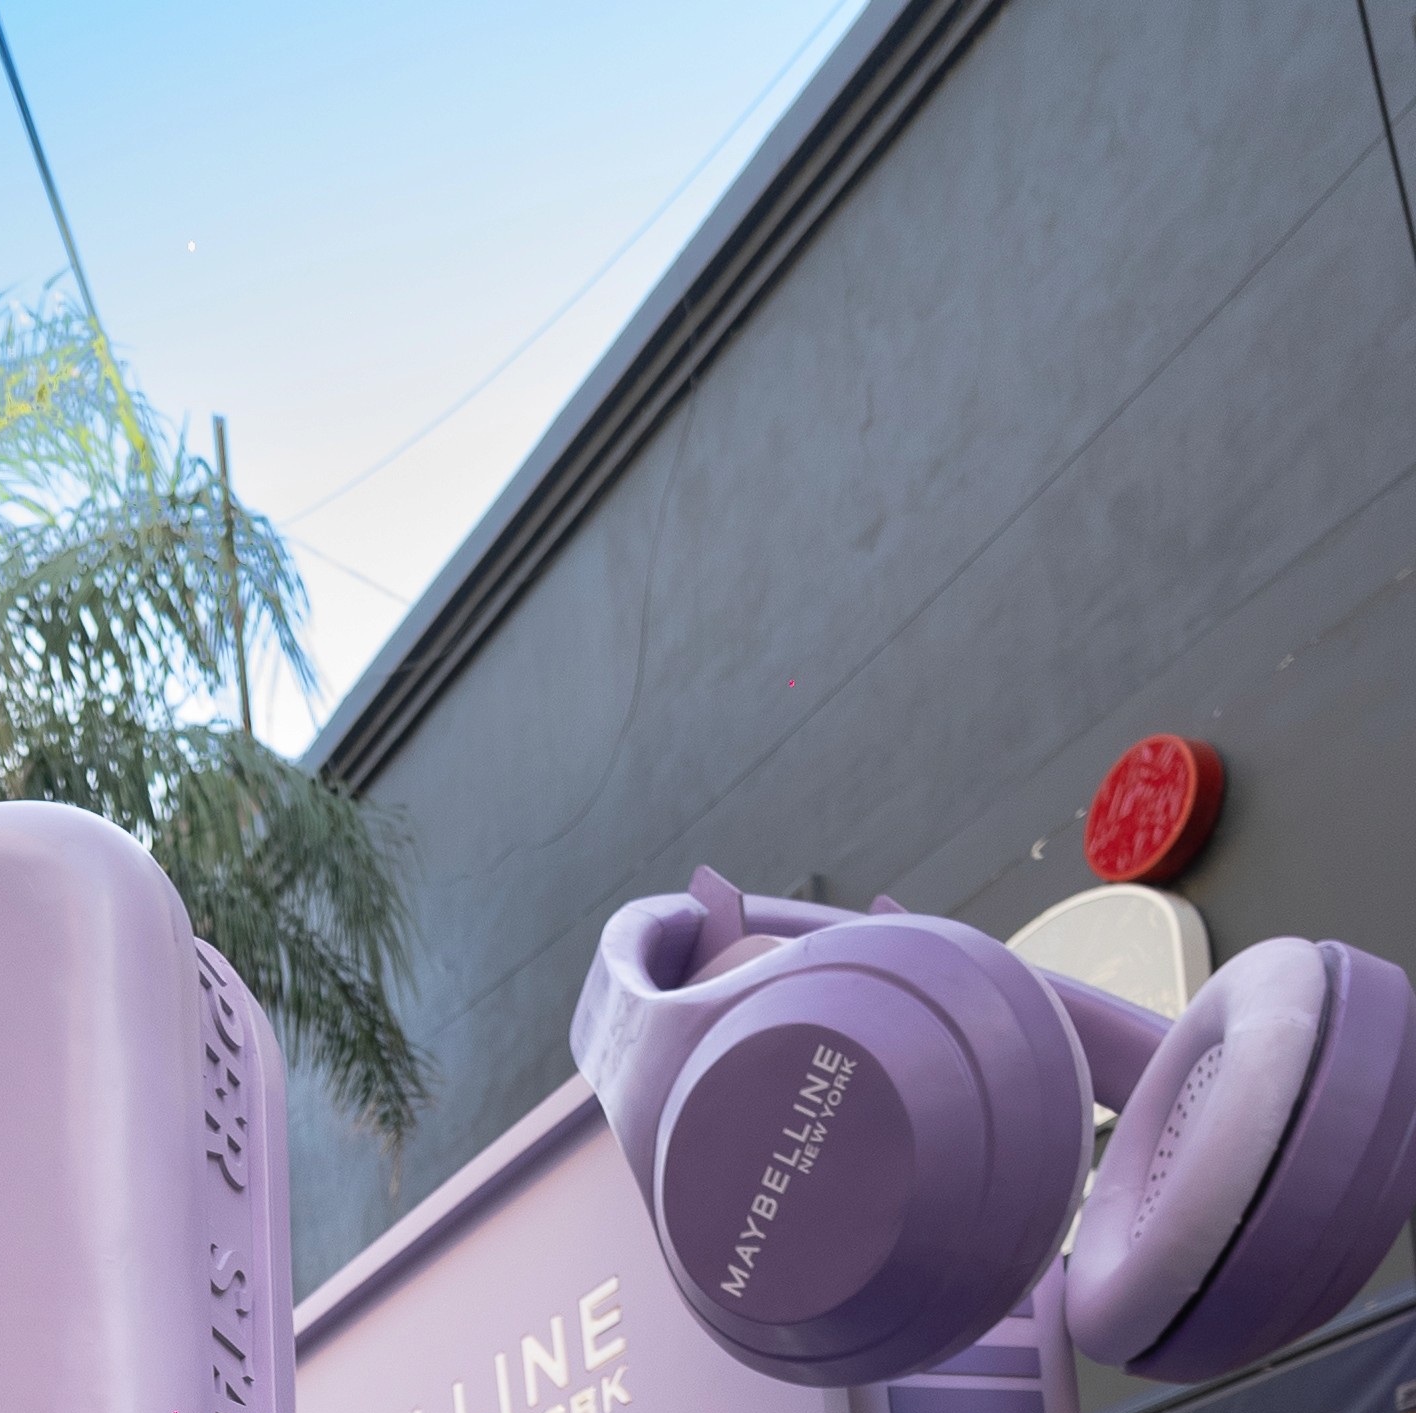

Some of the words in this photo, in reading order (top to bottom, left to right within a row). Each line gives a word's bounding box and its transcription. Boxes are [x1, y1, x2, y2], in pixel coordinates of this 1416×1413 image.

[196, 947, 257, 1191] PER
[721, 1044, 845, 1299] MAYBELLINE
[798, 1121, 829, 1175] NEW
[820, 1057, 857, 1118] YORK
